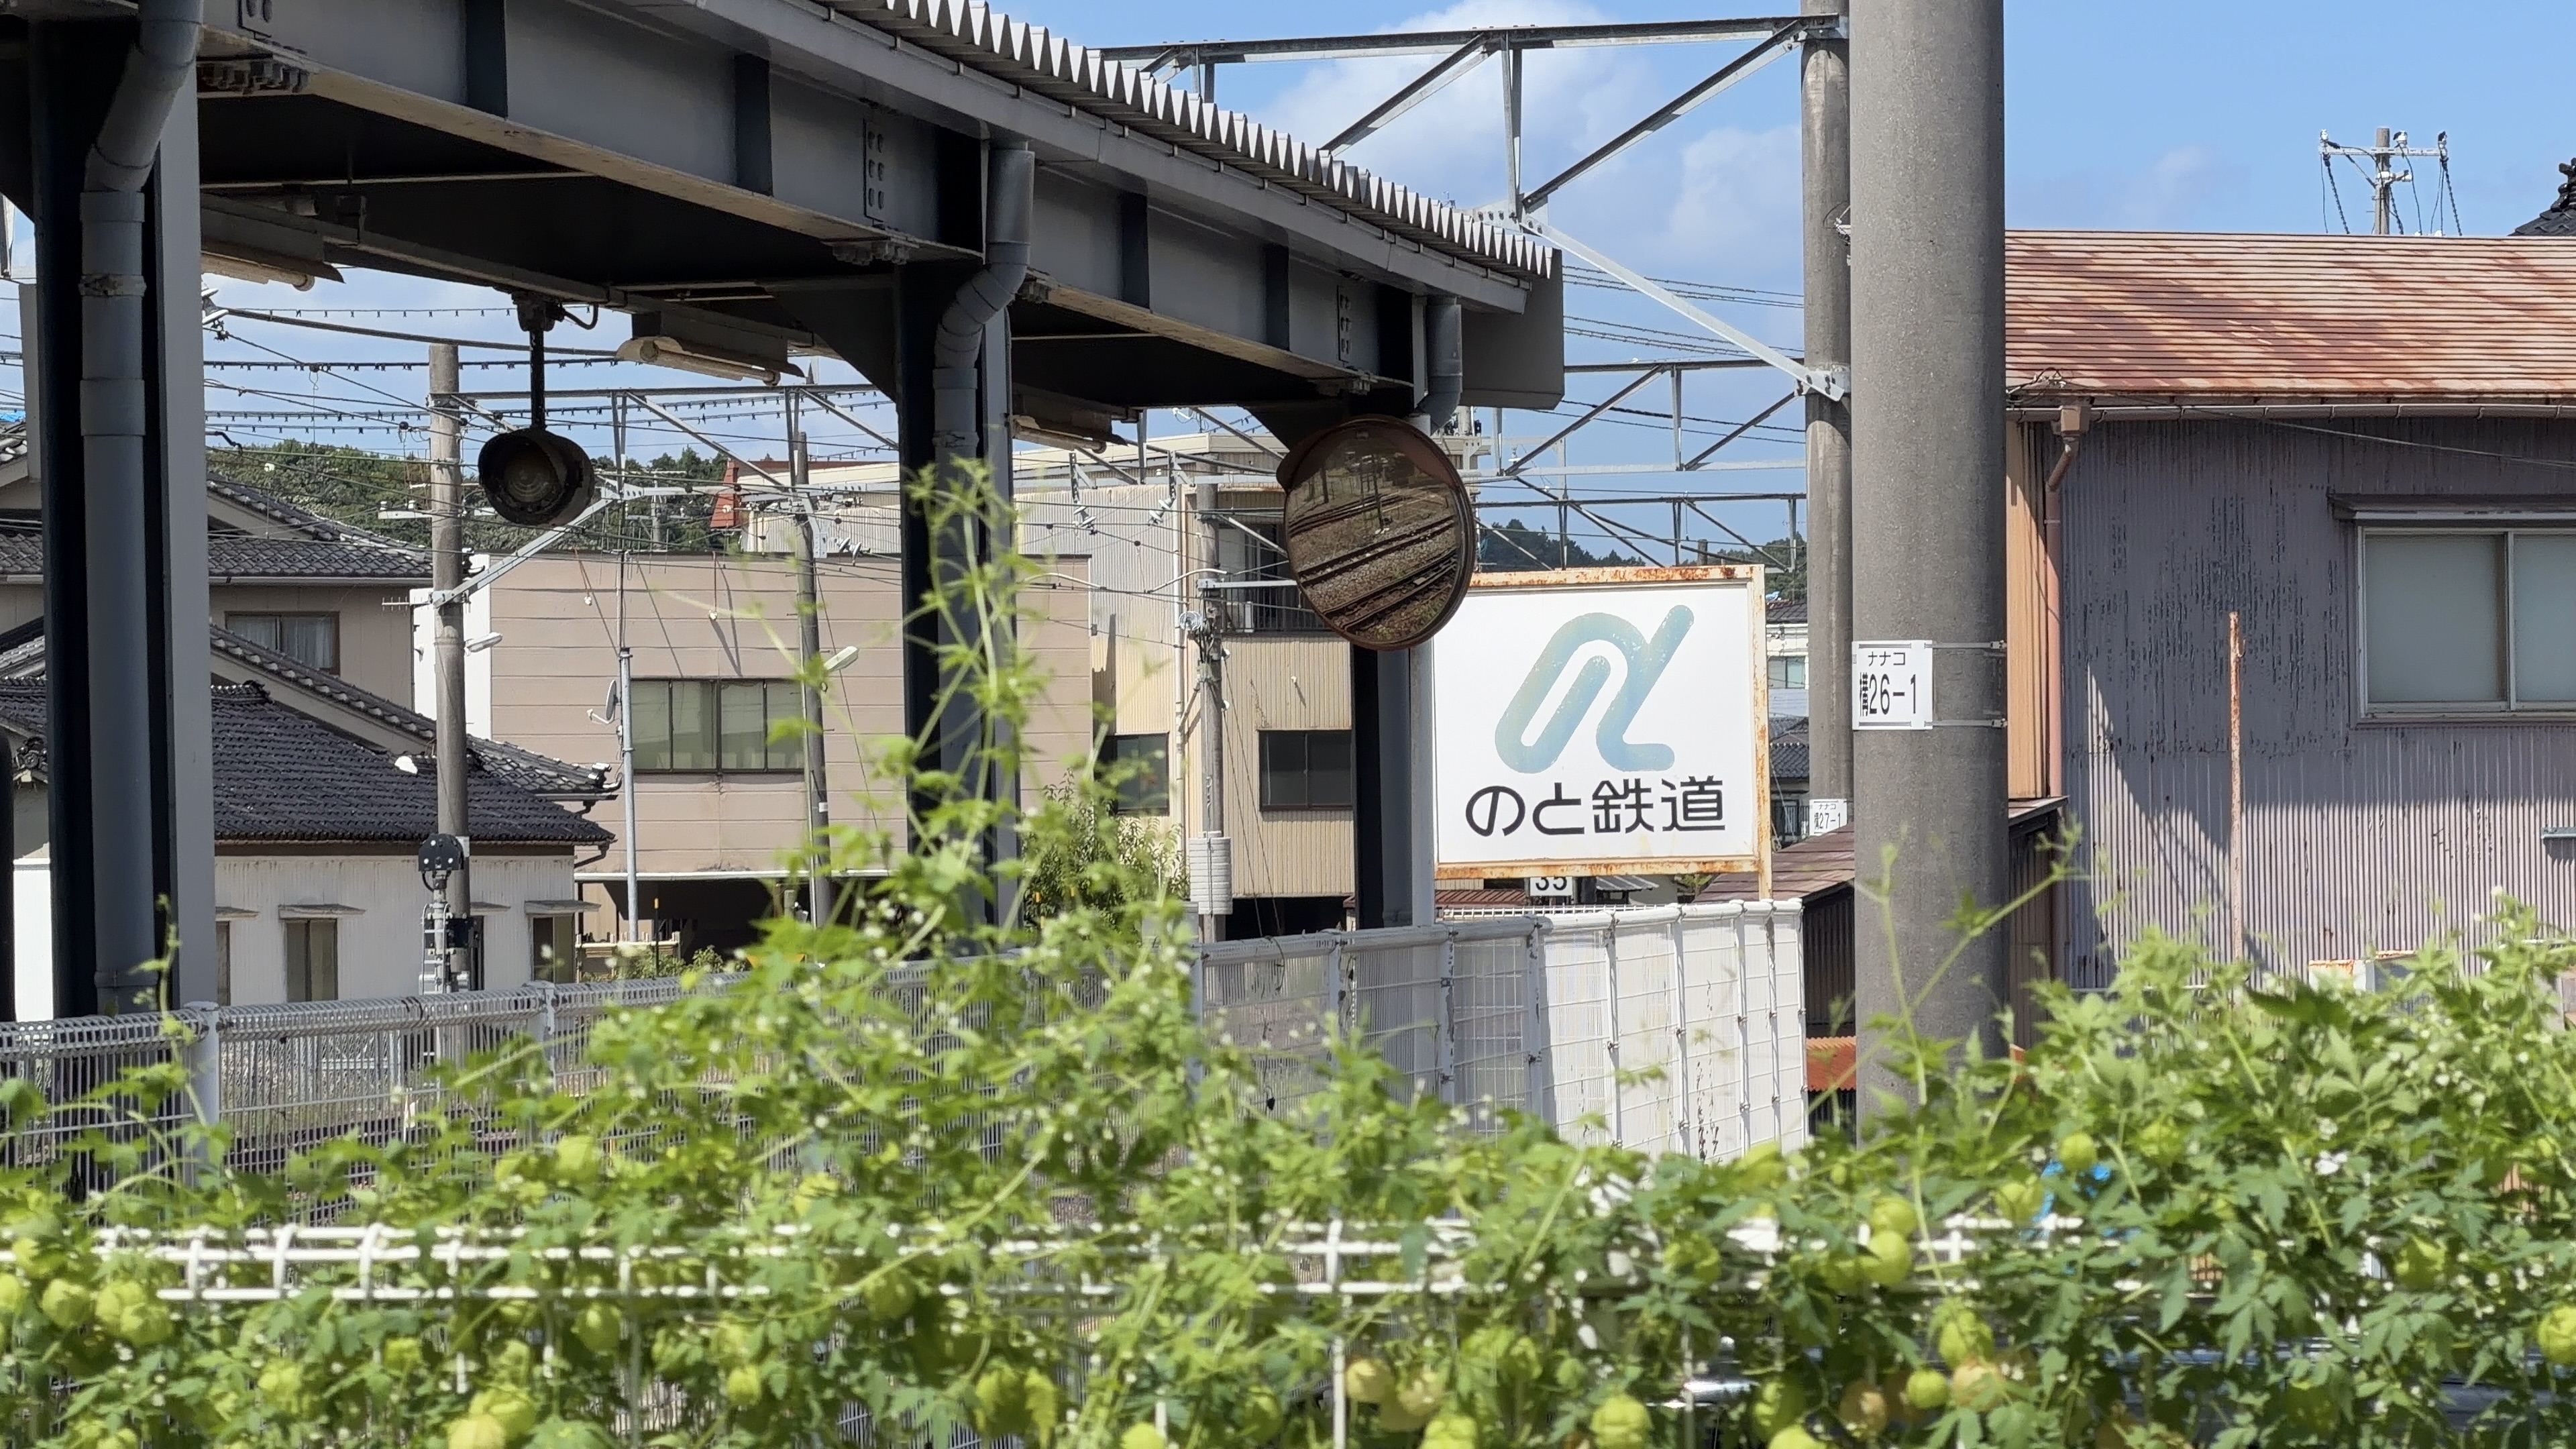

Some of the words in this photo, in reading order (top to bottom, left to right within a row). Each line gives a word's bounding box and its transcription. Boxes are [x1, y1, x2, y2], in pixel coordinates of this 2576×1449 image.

[1868, 651, 1906, 667] ナナコ
[1465, 775, 1726, 837] のと鉄道
